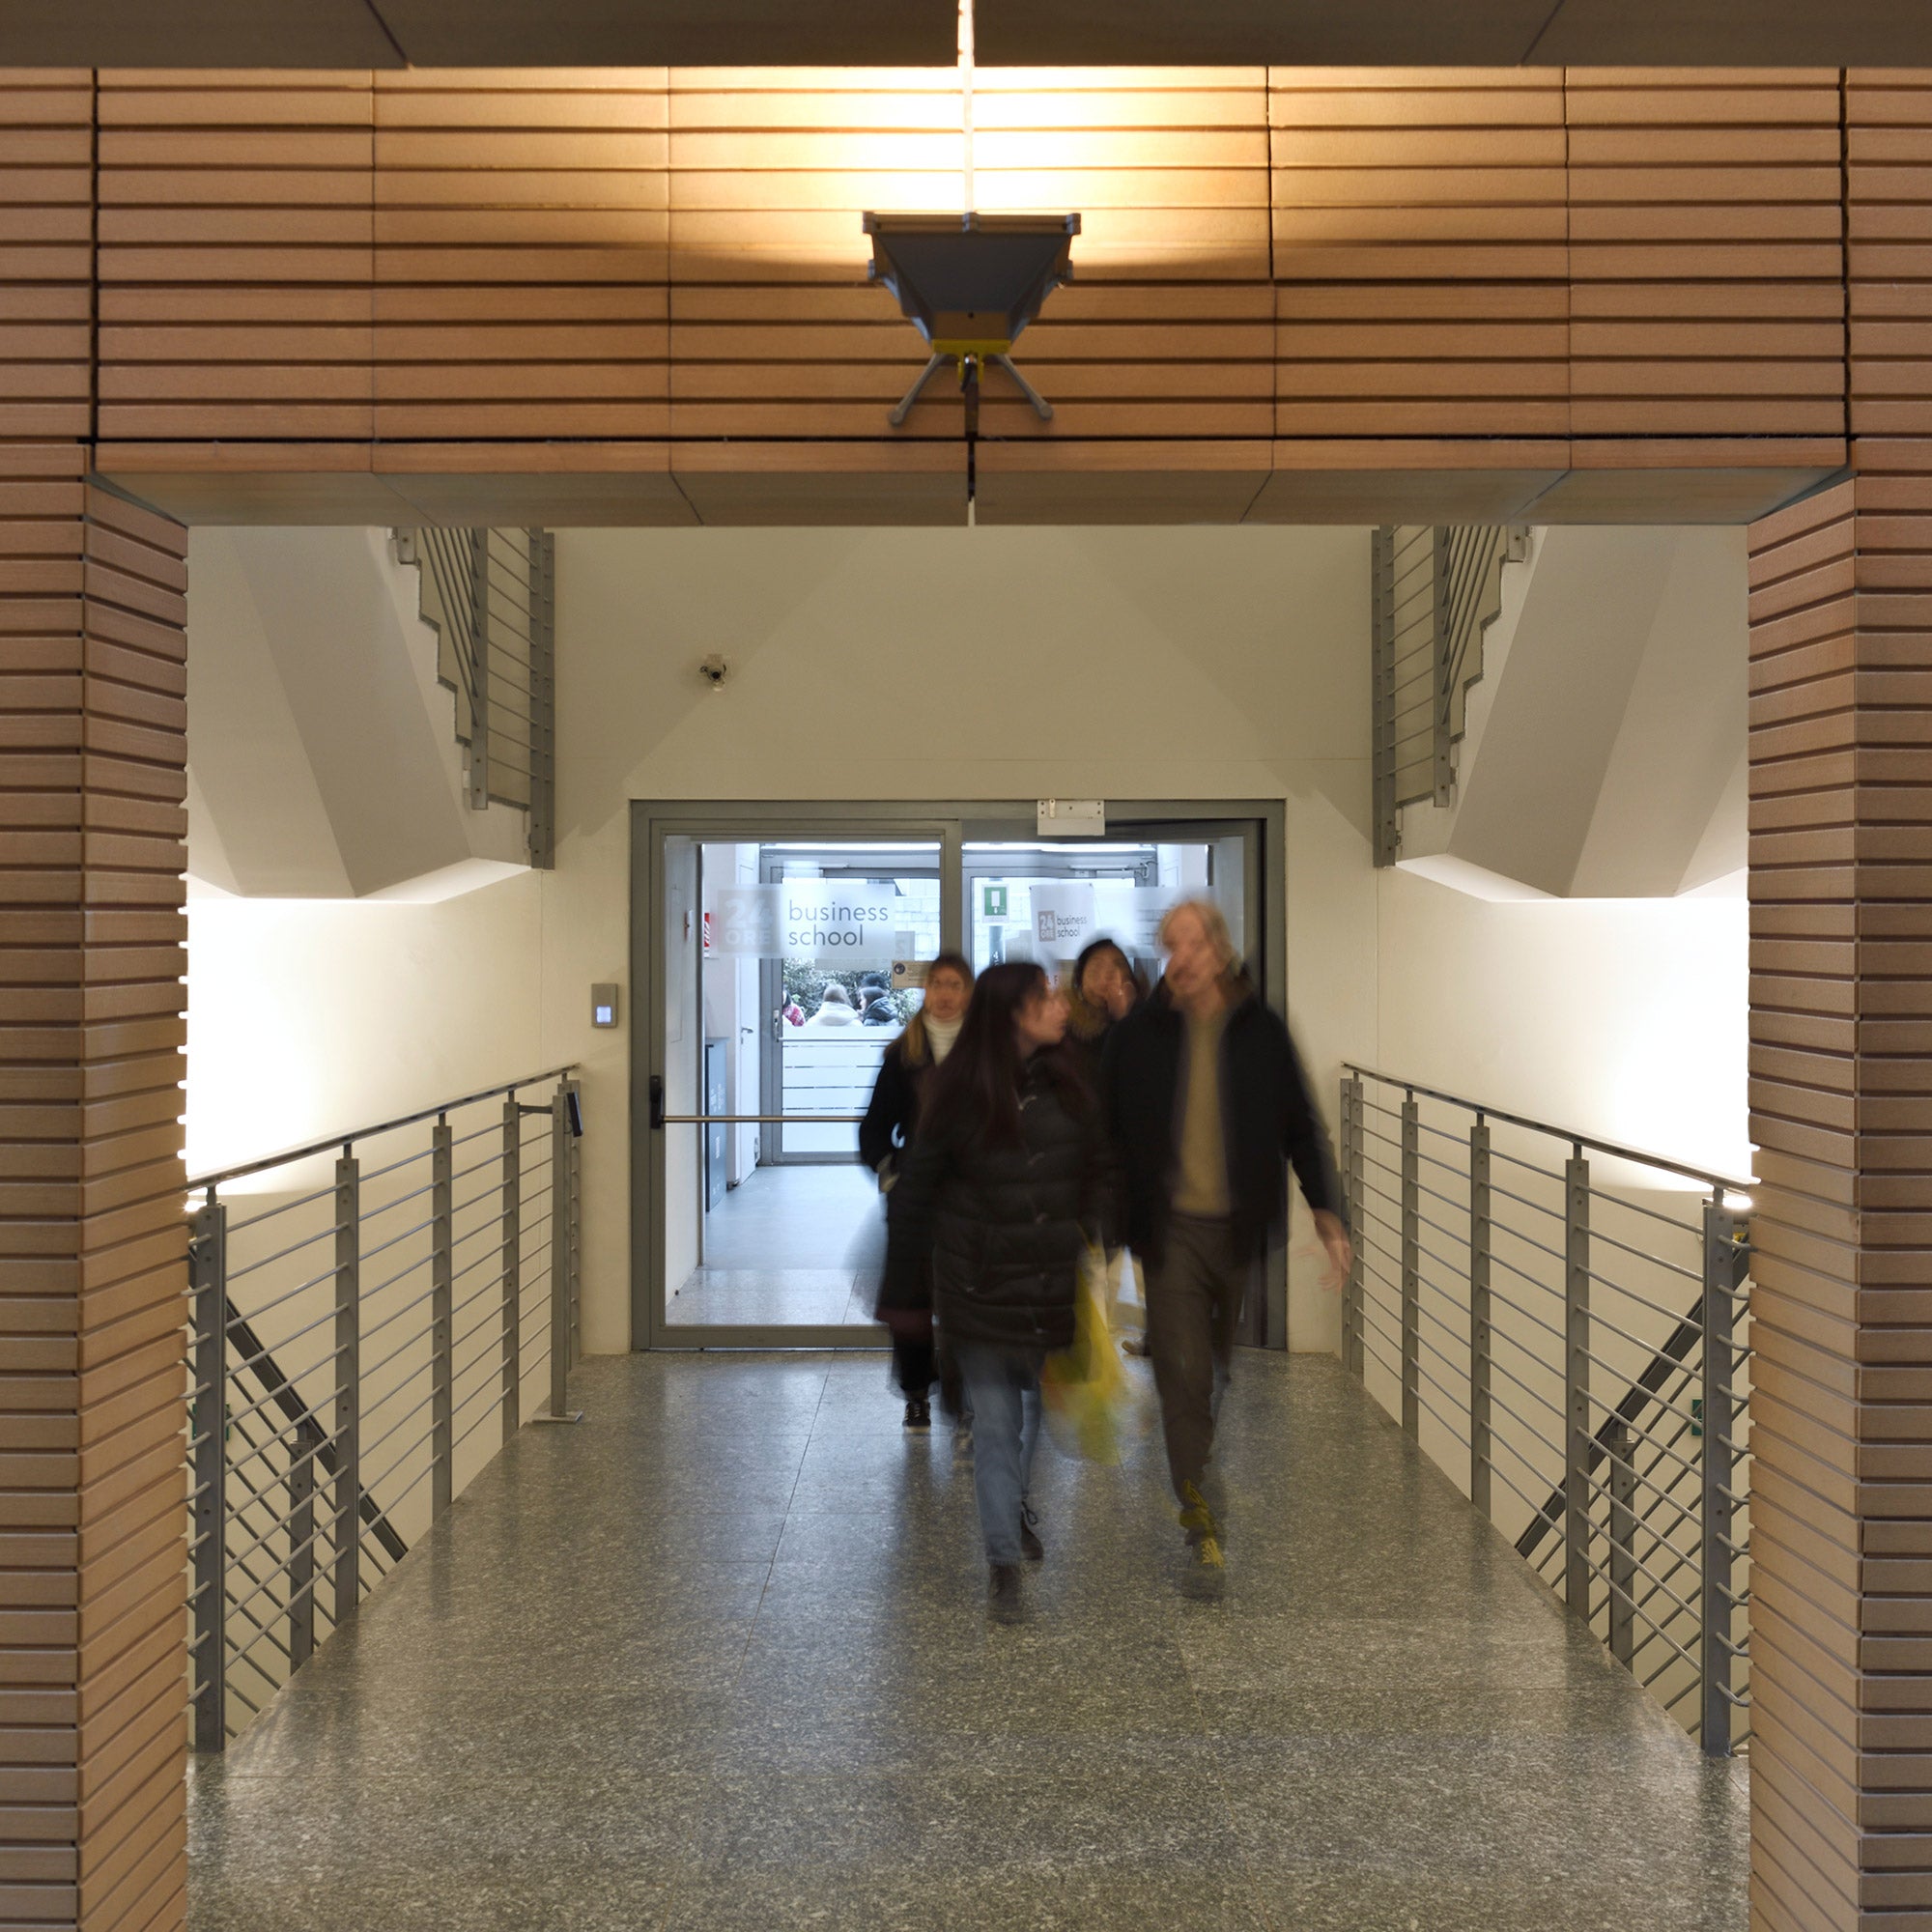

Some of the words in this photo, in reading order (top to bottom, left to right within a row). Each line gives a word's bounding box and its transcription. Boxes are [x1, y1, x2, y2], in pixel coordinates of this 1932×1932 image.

[725, 898, 773, 928] 24
[788, 899, 889, 922] business
[1057, 914, 1088, 925] business
[725, 929, 771, 945] ORE
[788, 924, 864, 947] school
[1057, 925, 1081, 938] school
